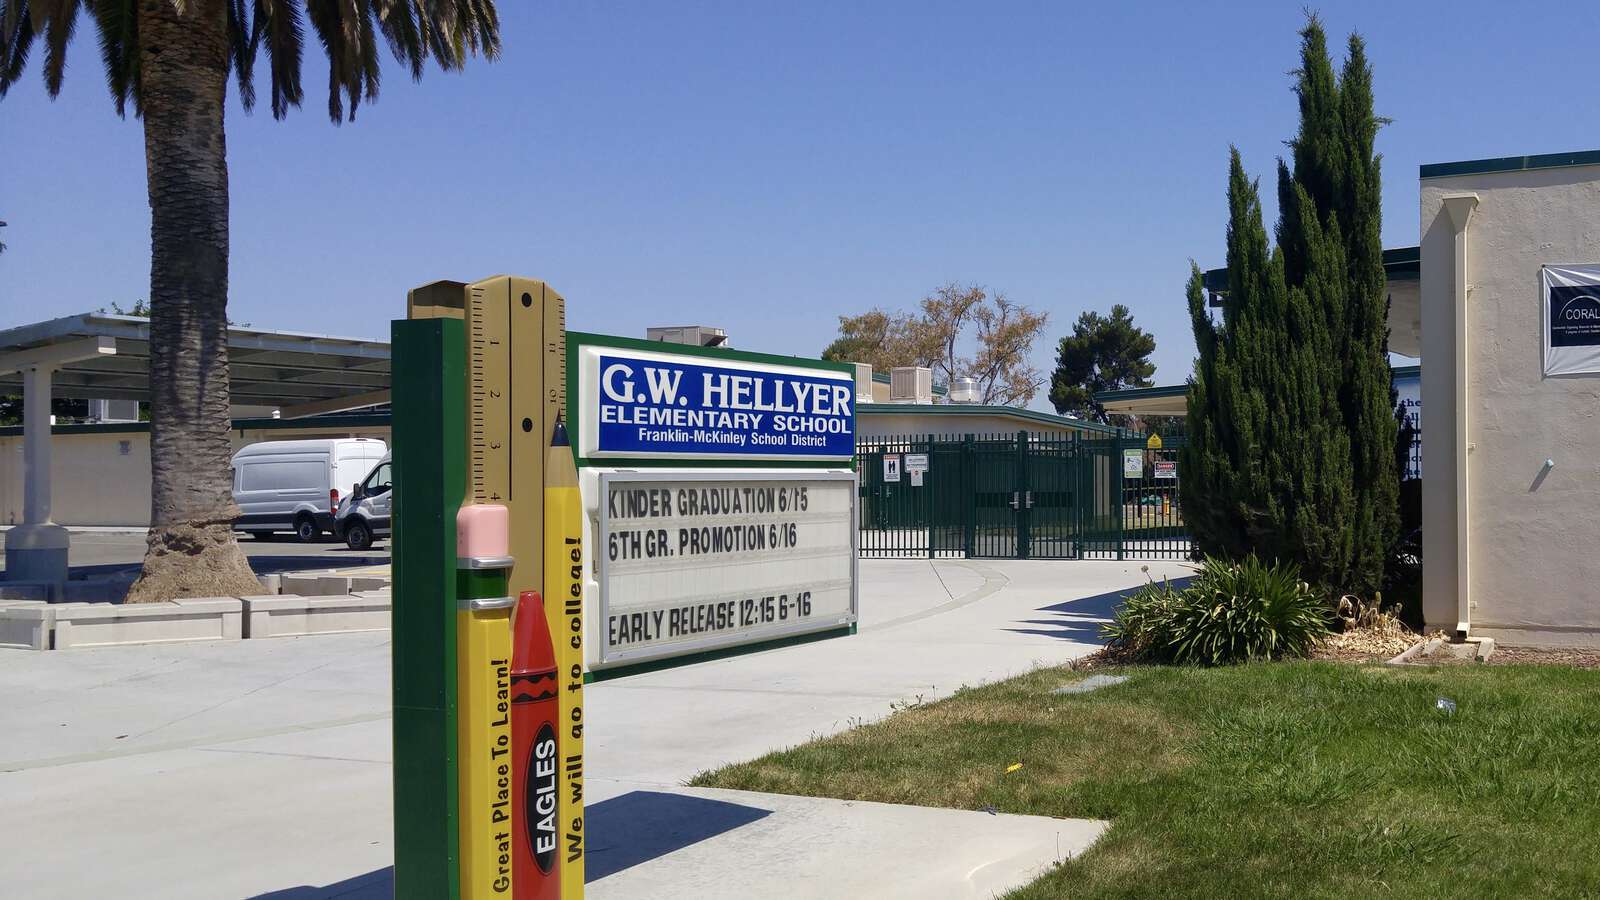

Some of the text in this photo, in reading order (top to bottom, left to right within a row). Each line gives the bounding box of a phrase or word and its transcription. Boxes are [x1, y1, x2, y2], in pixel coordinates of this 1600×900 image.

[1565, 308, 1600, 320] CORAL
[602, 363, 852, 416] G.W. HELLYER
[601, 404, 852, 434] ELEMENTARY SCHOOL
[639, 427, 827, 447] Franklin-McKinley School District
[490, 441, 501, 449] 3
[490, 493, 500, 501] 4
[608, 486, 808, 518] KINDER GRADUATION 6/15
[608, 522, 797, 562] 6TH GR. PROMOTION 6/16
[565, 537, 583, 649] college!
[608, 591, 811, 646] EARLY RELEASE 12:15 6-16
[568, 664, 582, 693] to
[491, 659, 510, 893] Great Place To Learn!
[566, 755, 583, 804] will
[536, 739, 556, 854] EAGLES
[566, 817, 583, 863] We
